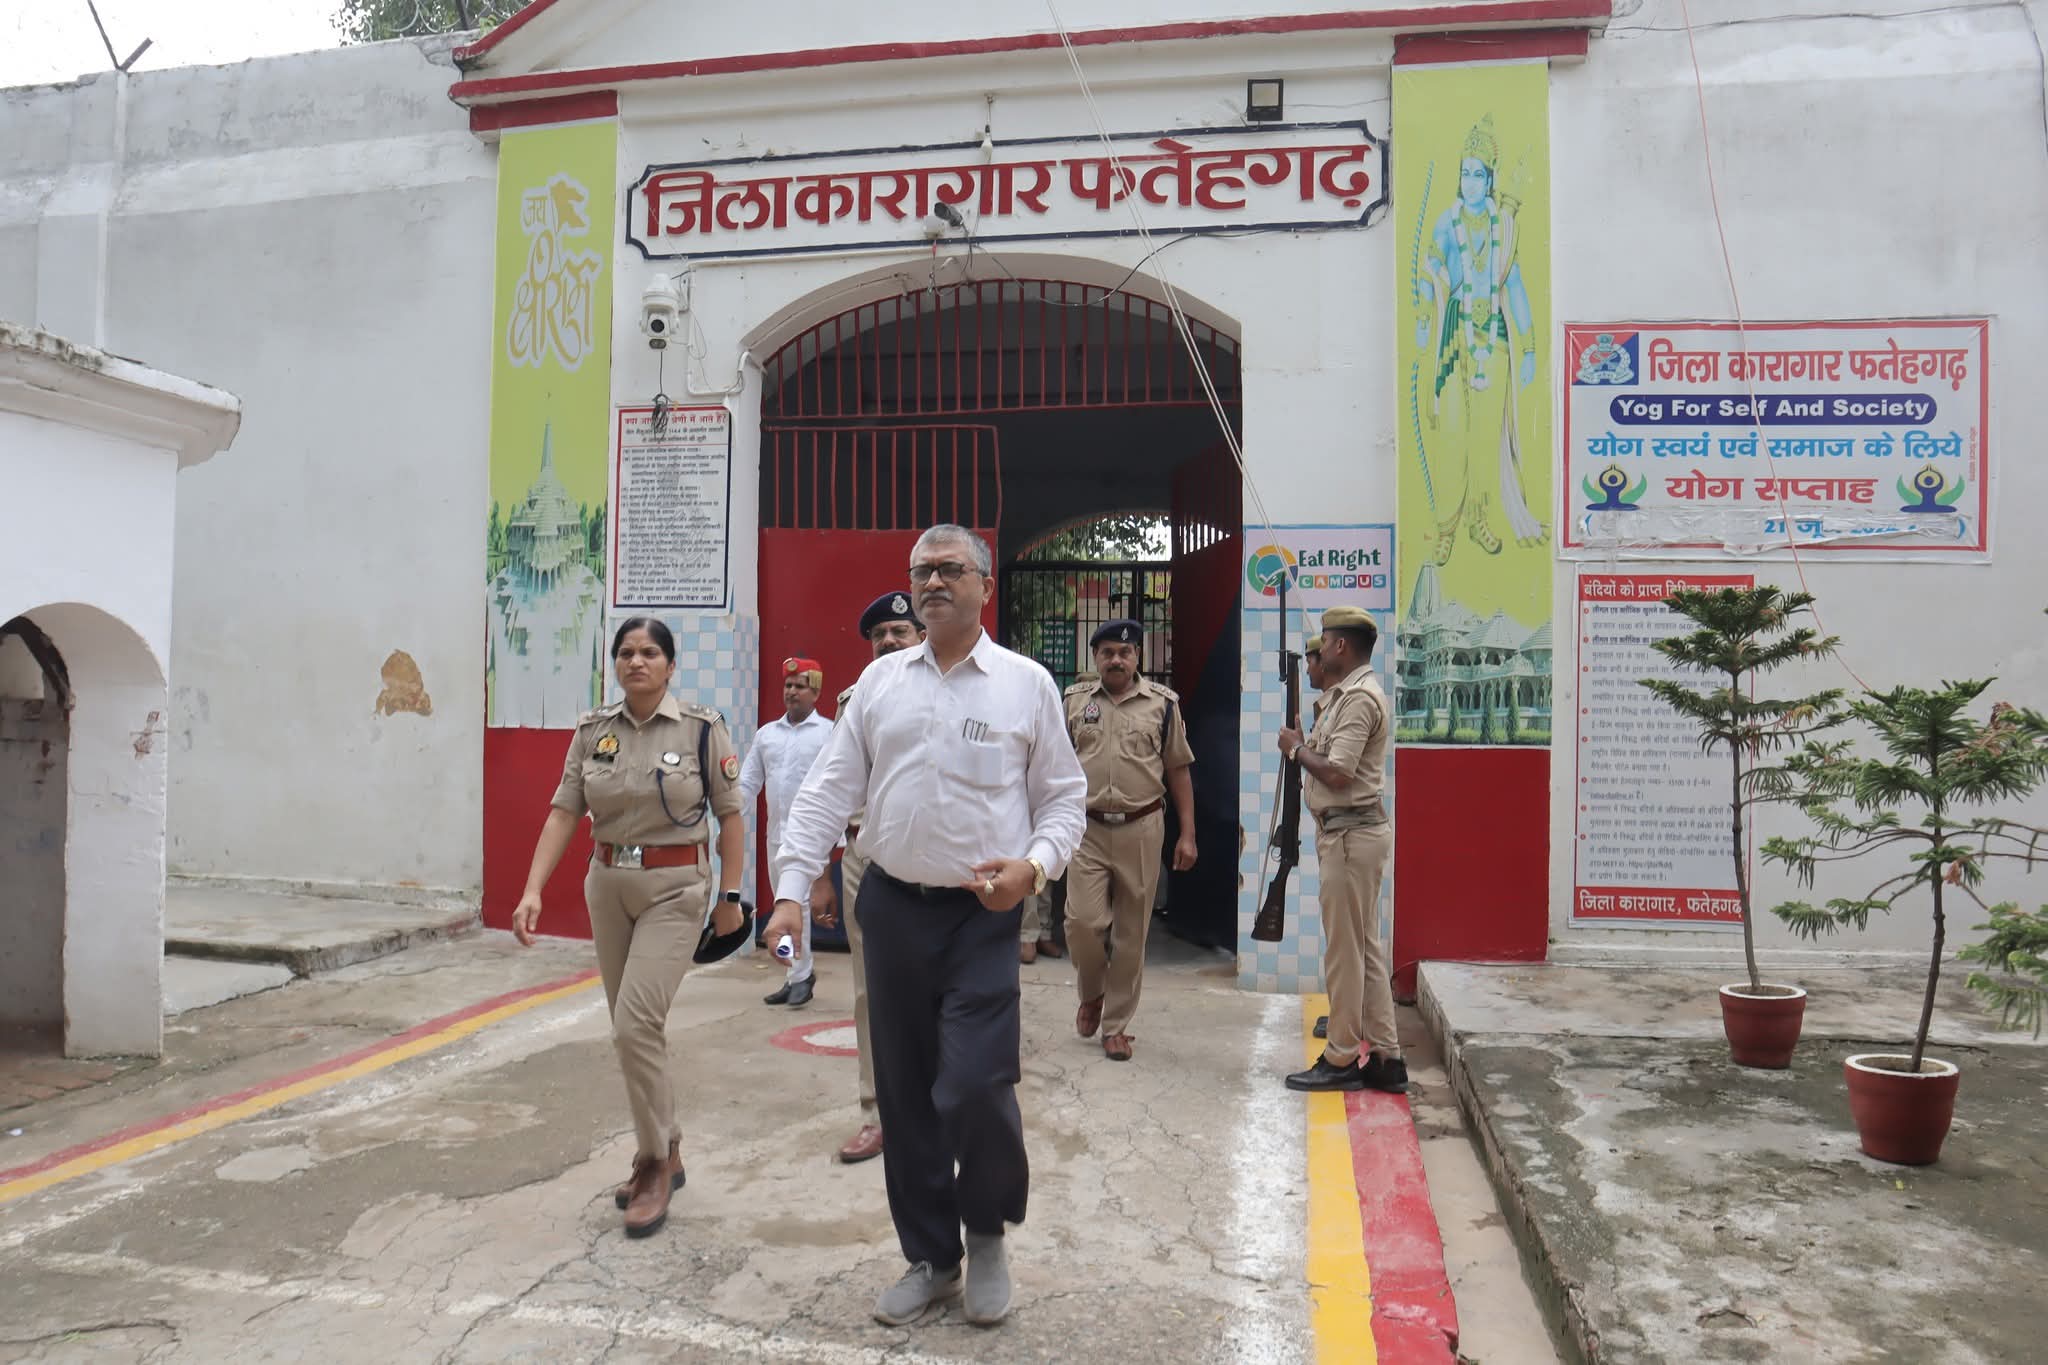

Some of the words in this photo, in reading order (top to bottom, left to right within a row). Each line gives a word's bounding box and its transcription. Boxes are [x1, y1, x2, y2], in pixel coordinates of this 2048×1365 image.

[642, 170, 788, 237] जिला
[794, 159, 1056, 226] कारागार
[1062, 138, 1371, 210] फतेहगढ़
[1648, 339, 1720, 383] जिला
[1728, 350, 1843, 382] कारागार
[1849, 337, 1969, 392] फतेहगढ़
[1618, 399, 1663, 417] Yog
[1672, 399, 1710, 416] For
[1719, 399, 1767, 416] Self
[1776, 399, 1824, 416] And
[1833, 398, 1929, 418] Society
[1587, 431, 1644, 458] योग
[1652, 431, 1711, 457] स्वयं
[1719, 431, 1761, 457] एवं
[1768, 437, 1856, 458] समाज
[1864, 430, 1894, 457] के
[1903, 430, 1963, 457] लिये
[1664, 468, 1744, 500] योग
[1754, 476, 1879, 503] सप्ताह
[1299, 549, 1324, 567] Eat
[1328, 549, 1382, 571] Right
[1300, 575, 1385, 588] CAMPUS
[1584, 579, 1616, 597] बंदियों
[1620, 579, 1634, 597] को
[1638, 583, 1663, 598] प्राप्त
[1579, 889, 1615, 911] जिला
[1619, 894, 1682, 915] कारागार,
